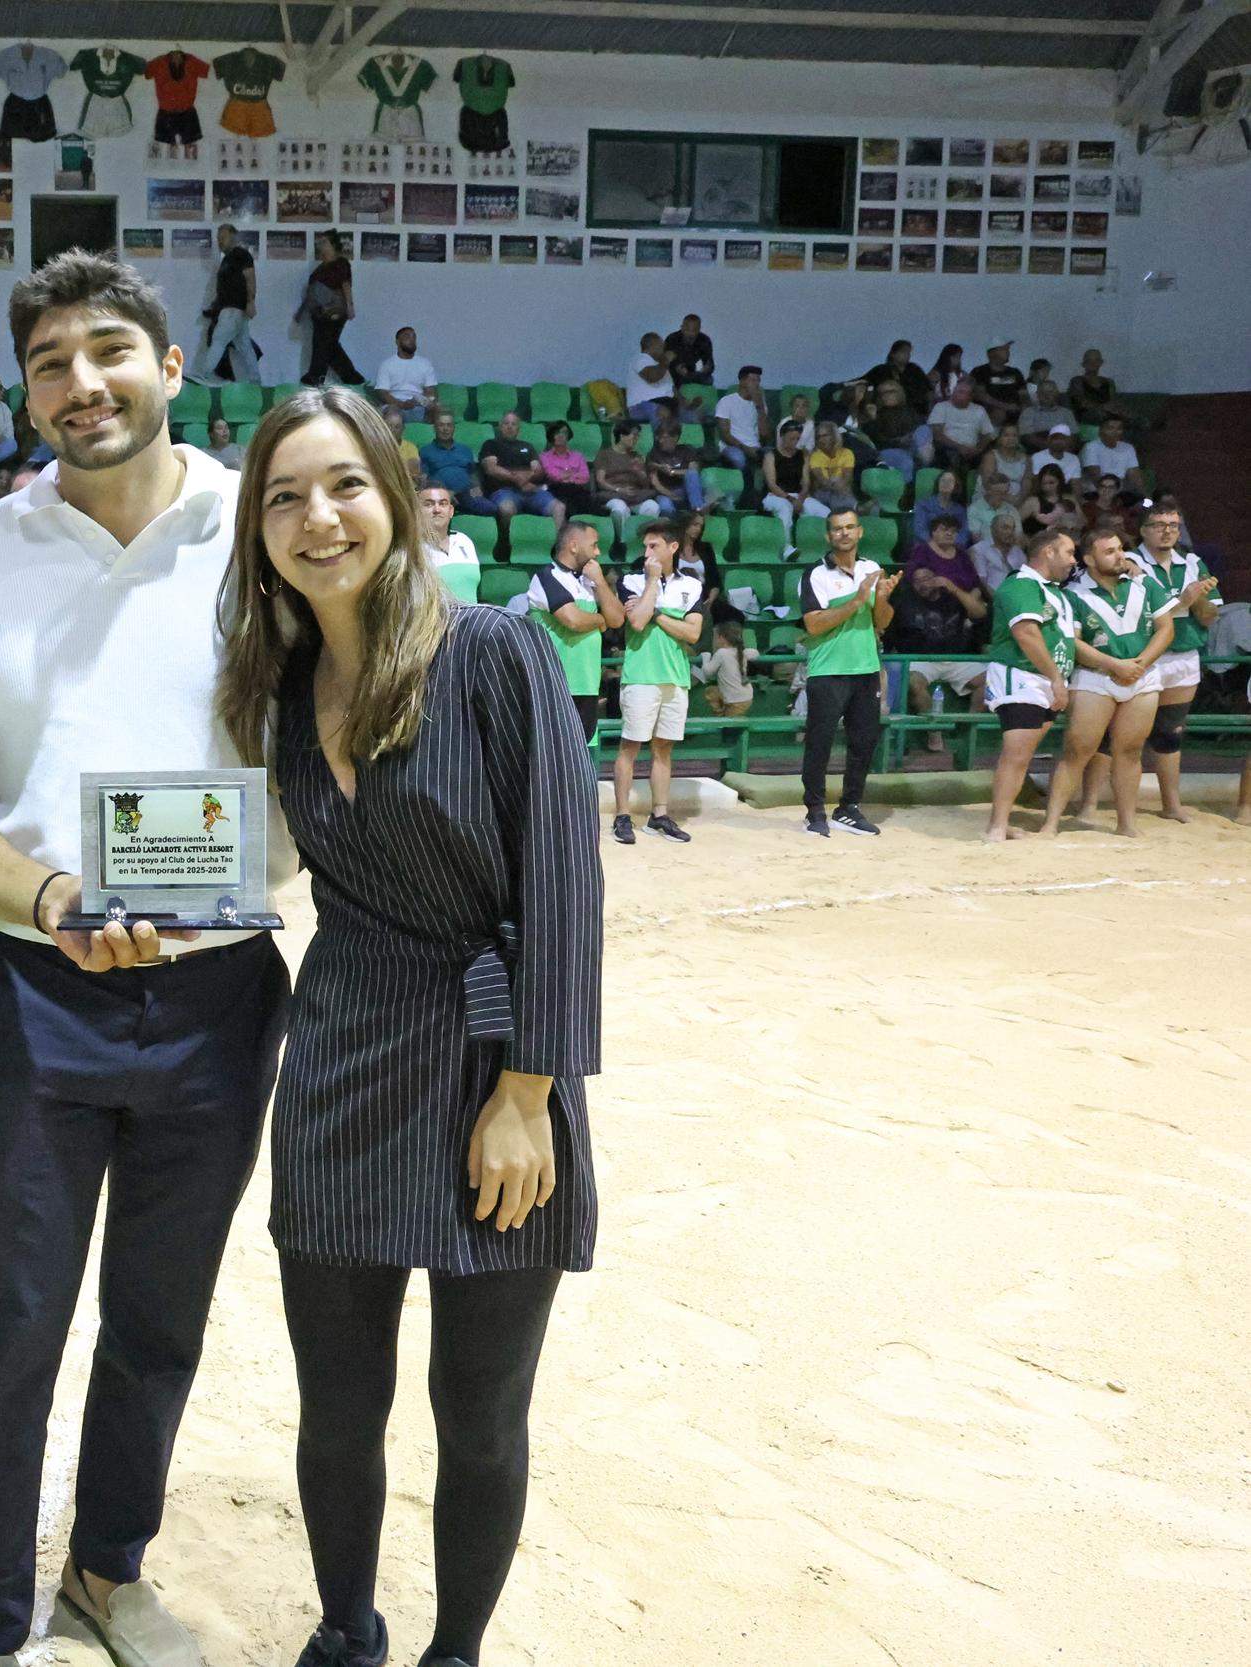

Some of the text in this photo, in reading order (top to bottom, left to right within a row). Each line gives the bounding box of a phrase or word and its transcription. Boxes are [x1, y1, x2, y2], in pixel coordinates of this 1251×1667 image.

[143, 836, 207, 845] Agradecimiento
[112, 845, 234, 853] BARCELÓ LANZAROTE ACTIVE RESORT
[140, 867, 185, 875] Temporada
[187, 866, 228, 874] 2025-2026
